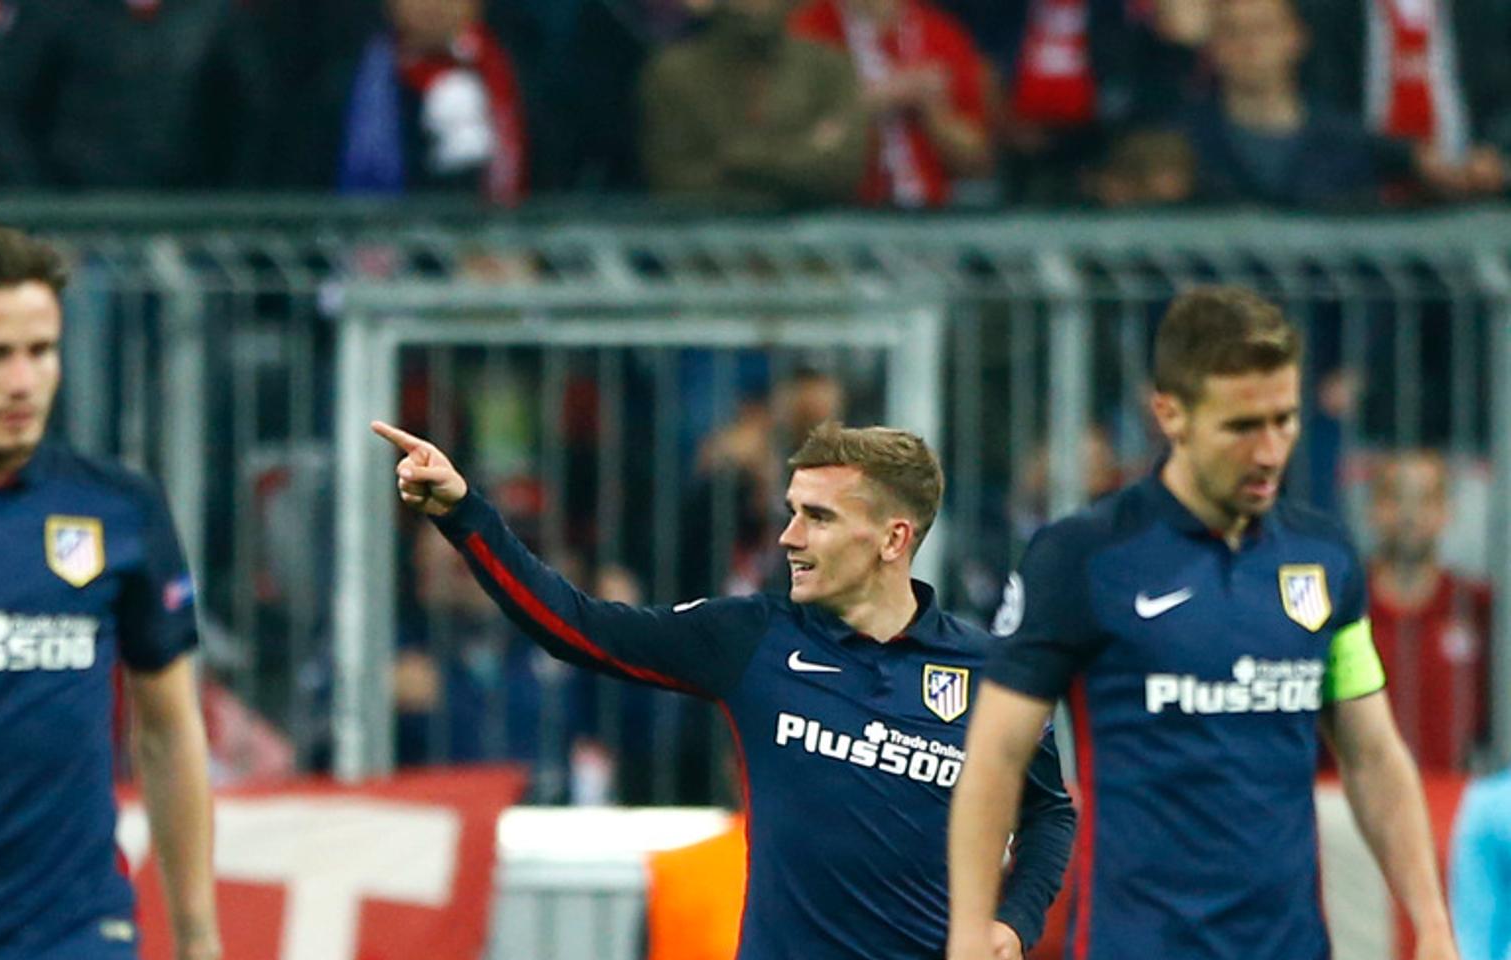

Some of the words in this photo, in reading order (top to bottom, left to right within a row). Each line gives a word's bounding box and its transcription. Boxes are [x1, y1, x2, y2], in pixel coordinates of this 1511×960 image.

[1147, 672, 1323, 714] Plus500
[776, 711, 962, 787] Plus500
[888, 729, 928, 751] Trade
